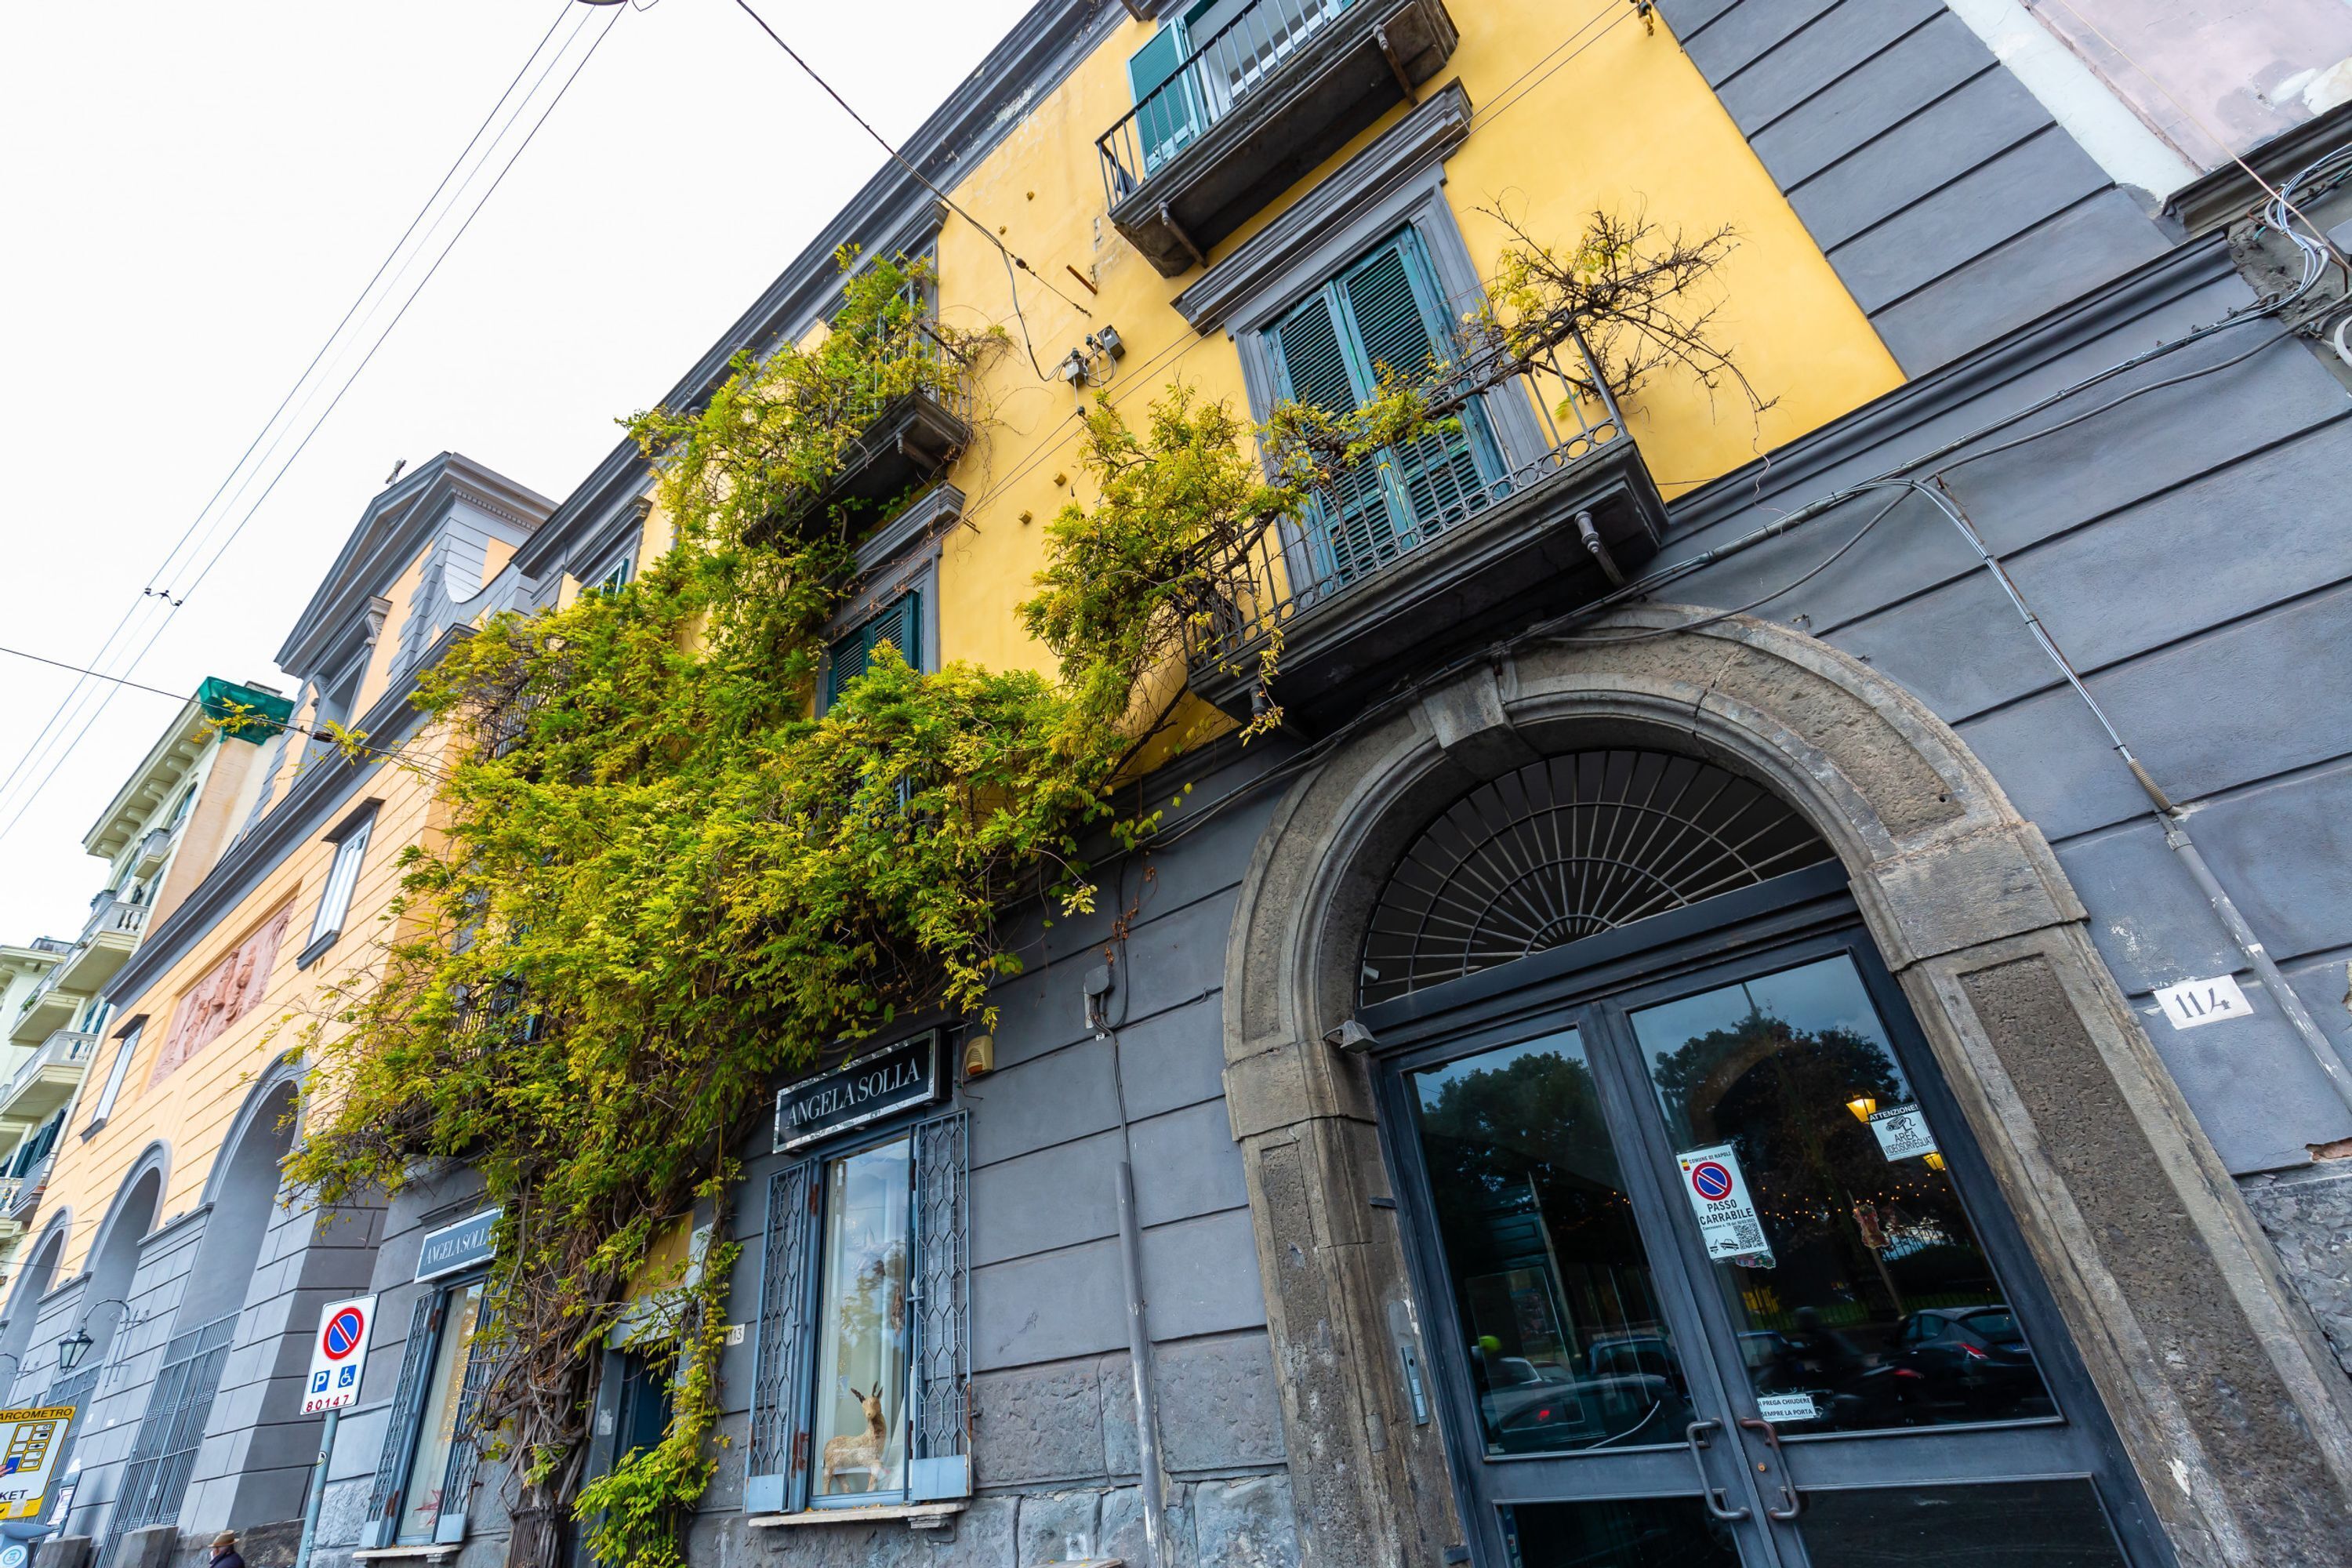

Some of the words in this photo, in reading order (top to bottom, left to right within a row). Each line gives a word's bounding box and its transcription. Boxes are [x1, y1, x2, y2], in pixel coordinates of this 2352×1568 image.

[2175, 987, 2232, 1018] 114
[785, 1082, 856, 1129] ANGELA
[858, 1058, 921, 1103] SOLLA
[1869, 1104, 1919, 1121] ATTENZIONE!
[1894, 1130, 1918, 1142] AREA
[1689, 1156, 1708, 1164] COMUNE
[1707, 1199, 1737, 1213] PASSO
[1699, 1207, 1754, 1225] CARRABILE
[424, 1236, 460, 1267] ANGELA
[729, 1327, 742, 1342] 113
[306, 1394, 350, 1412] 80147
